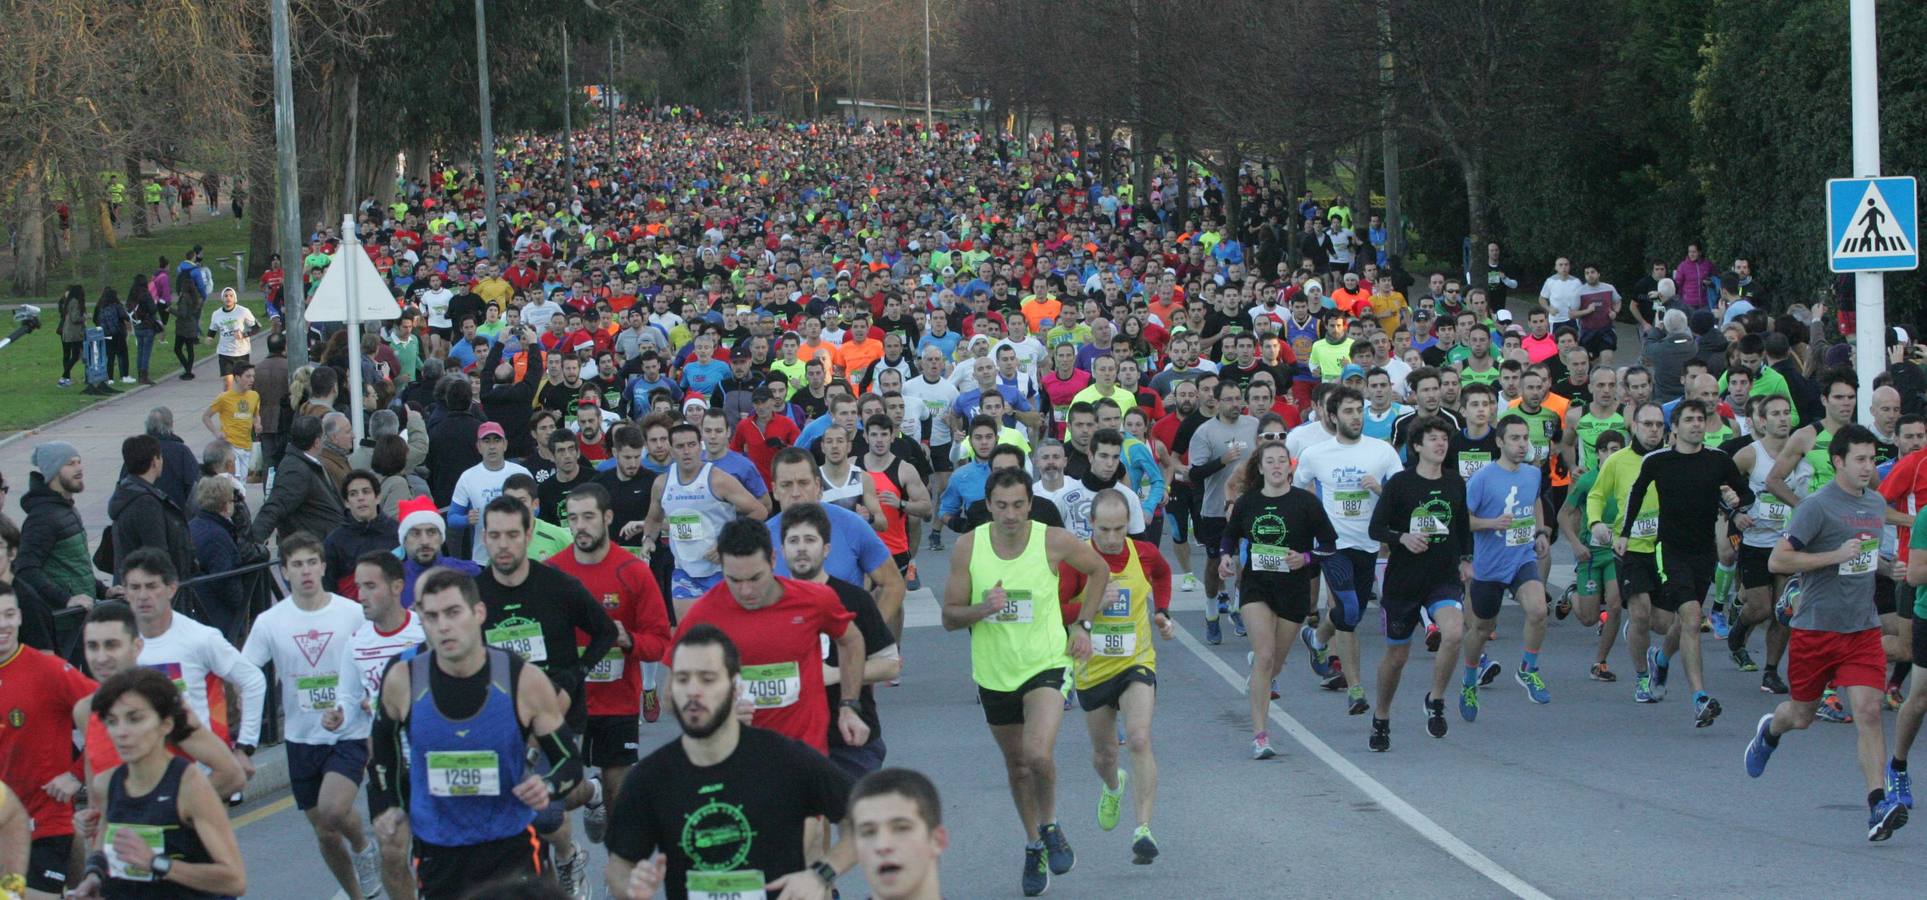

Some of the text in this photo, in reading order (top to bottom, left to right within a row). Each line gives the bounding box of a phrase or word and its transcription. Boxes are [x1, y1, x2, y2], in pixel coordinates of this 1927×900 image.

[1342, 500, 1361, 511] 1887
[1769, 503, 1785, 514] 577
[677, 523, 692, 535] 804
[1105, 634, 1123, 648] 961
[309, 687, 336, 702] 1546
[749, 679, 787, 697] 4090
[444, 768, 481, 786] 1296
